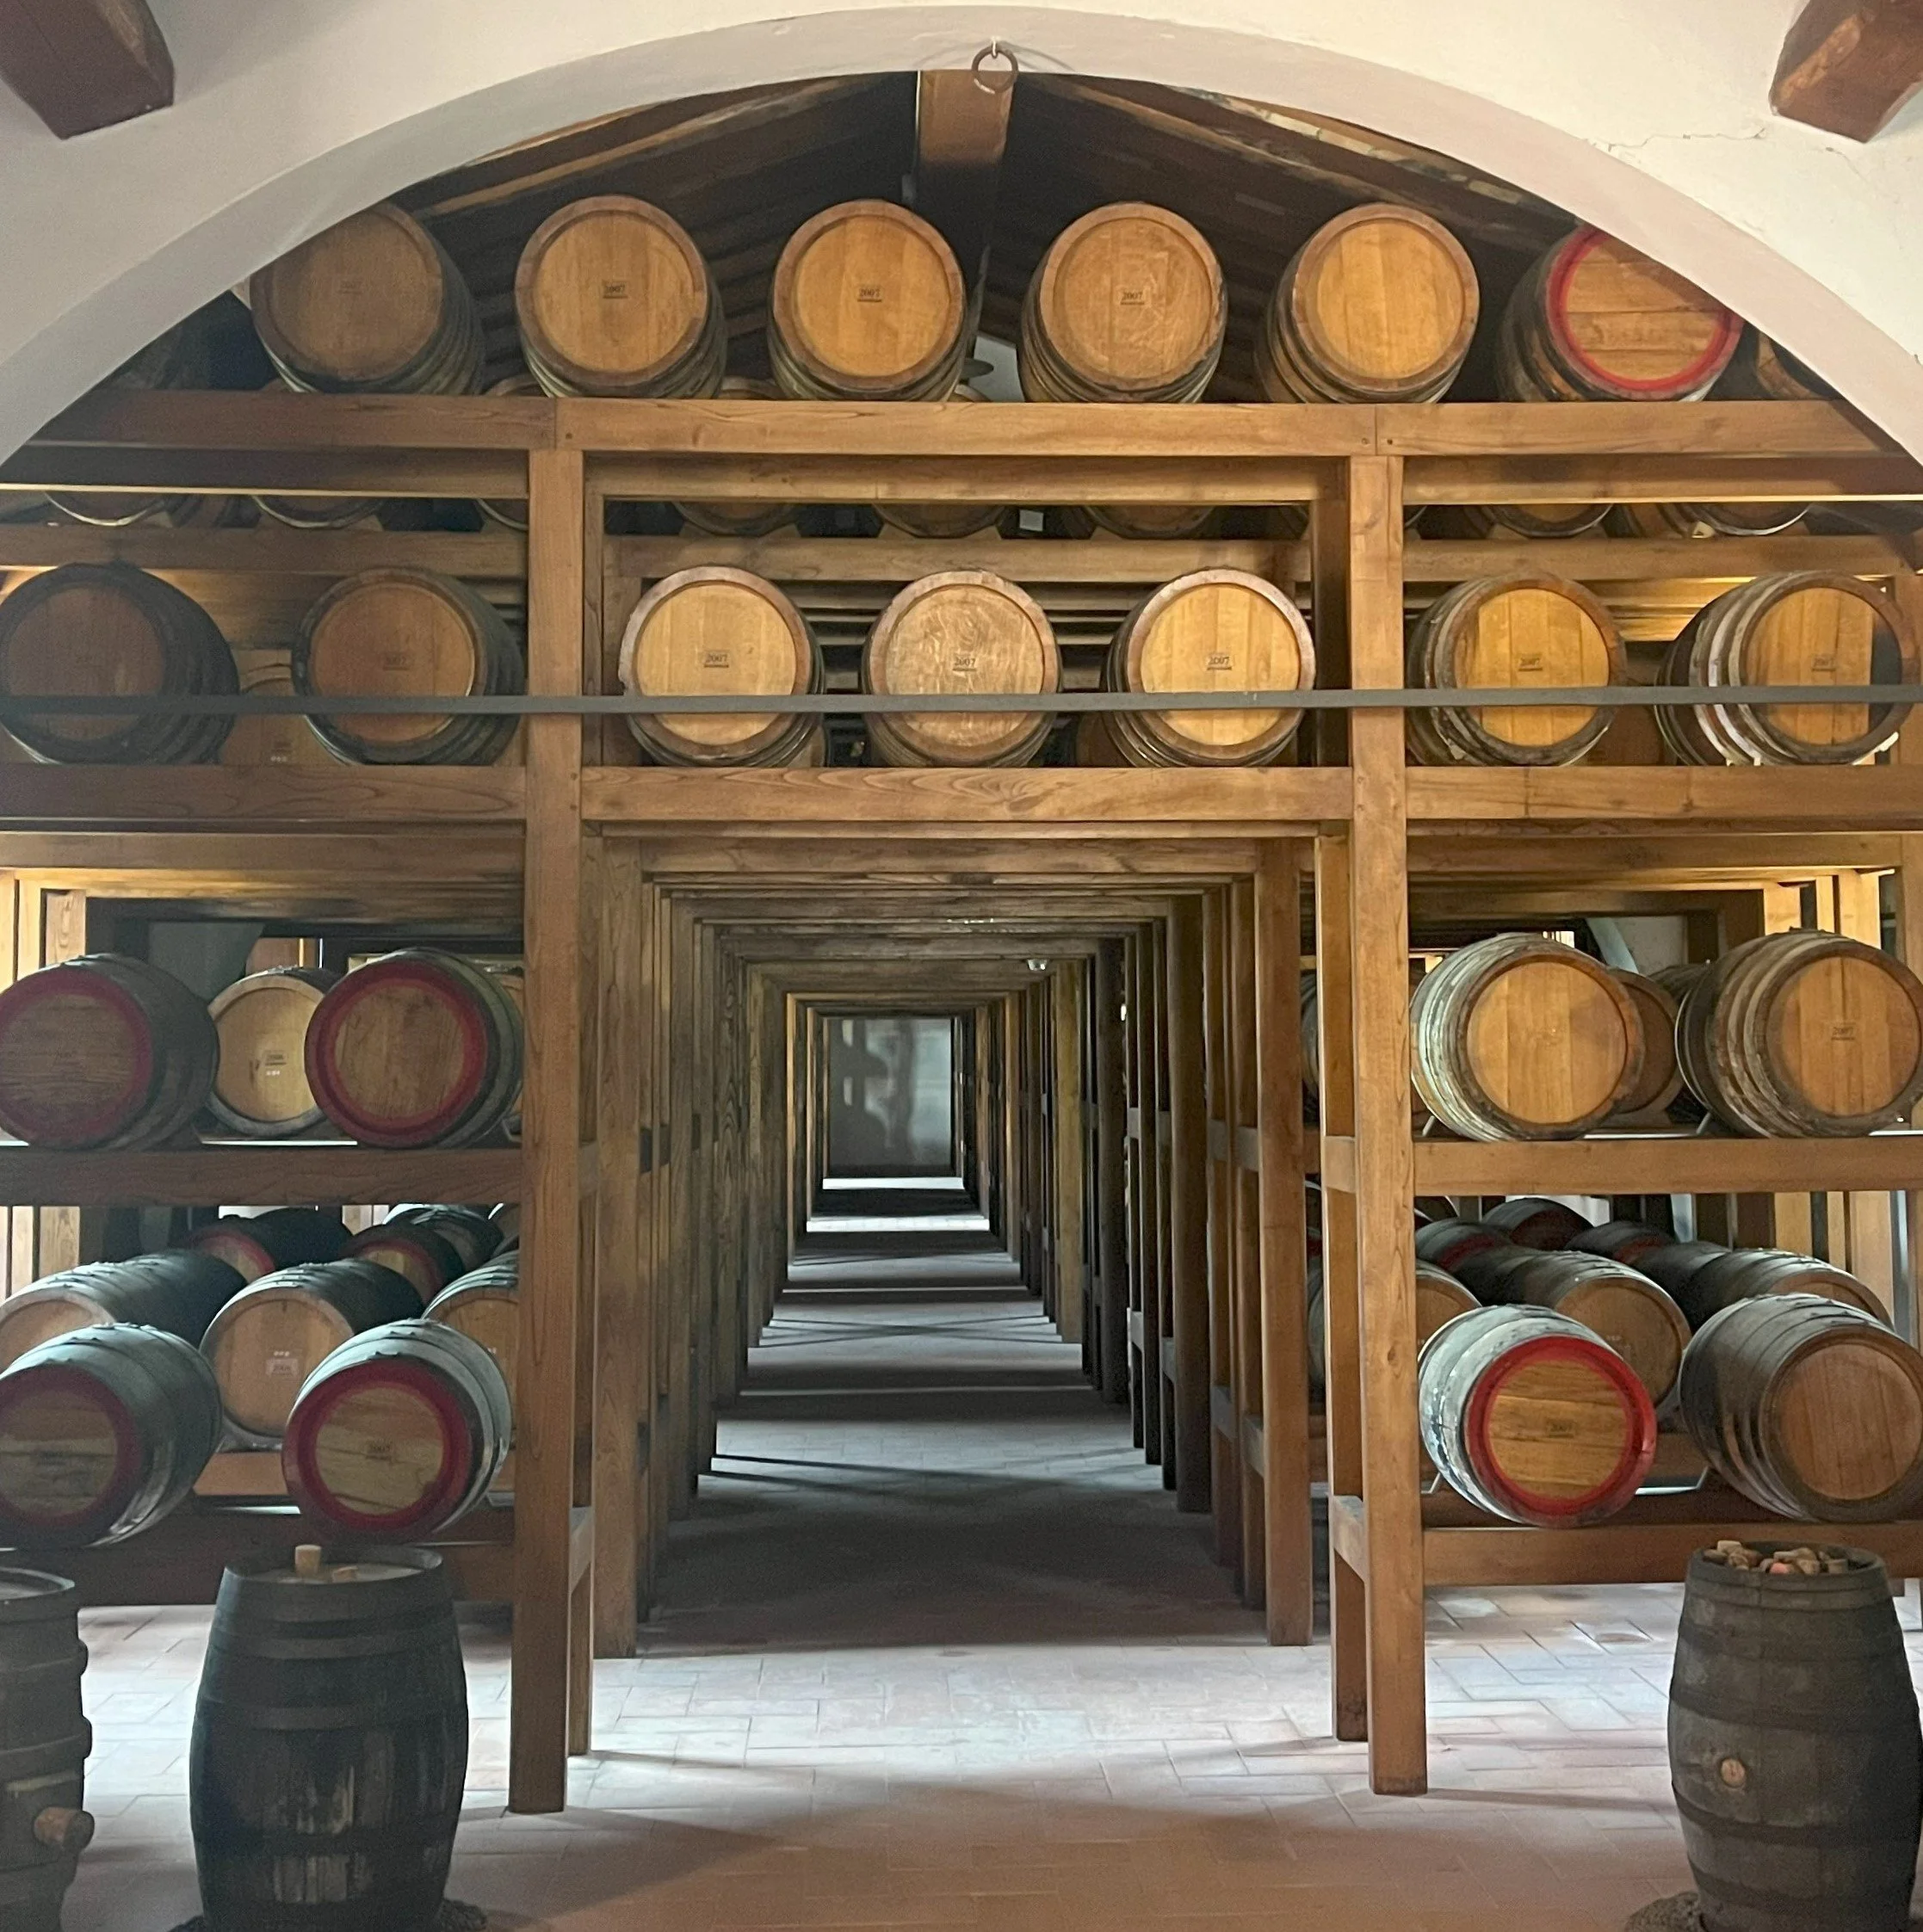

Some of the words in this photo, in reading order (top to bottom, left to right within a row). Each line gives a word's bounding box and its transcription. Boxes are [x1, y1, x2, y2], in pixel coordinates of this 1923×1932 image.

[859, 288, 881, 298] 2007
[1122, 291, 1143, 300] 2007
[706, 653, 727, 663] 2007
[955, 657, 976, 667] 2007
[1209, 656, 1230, 665] 2007
